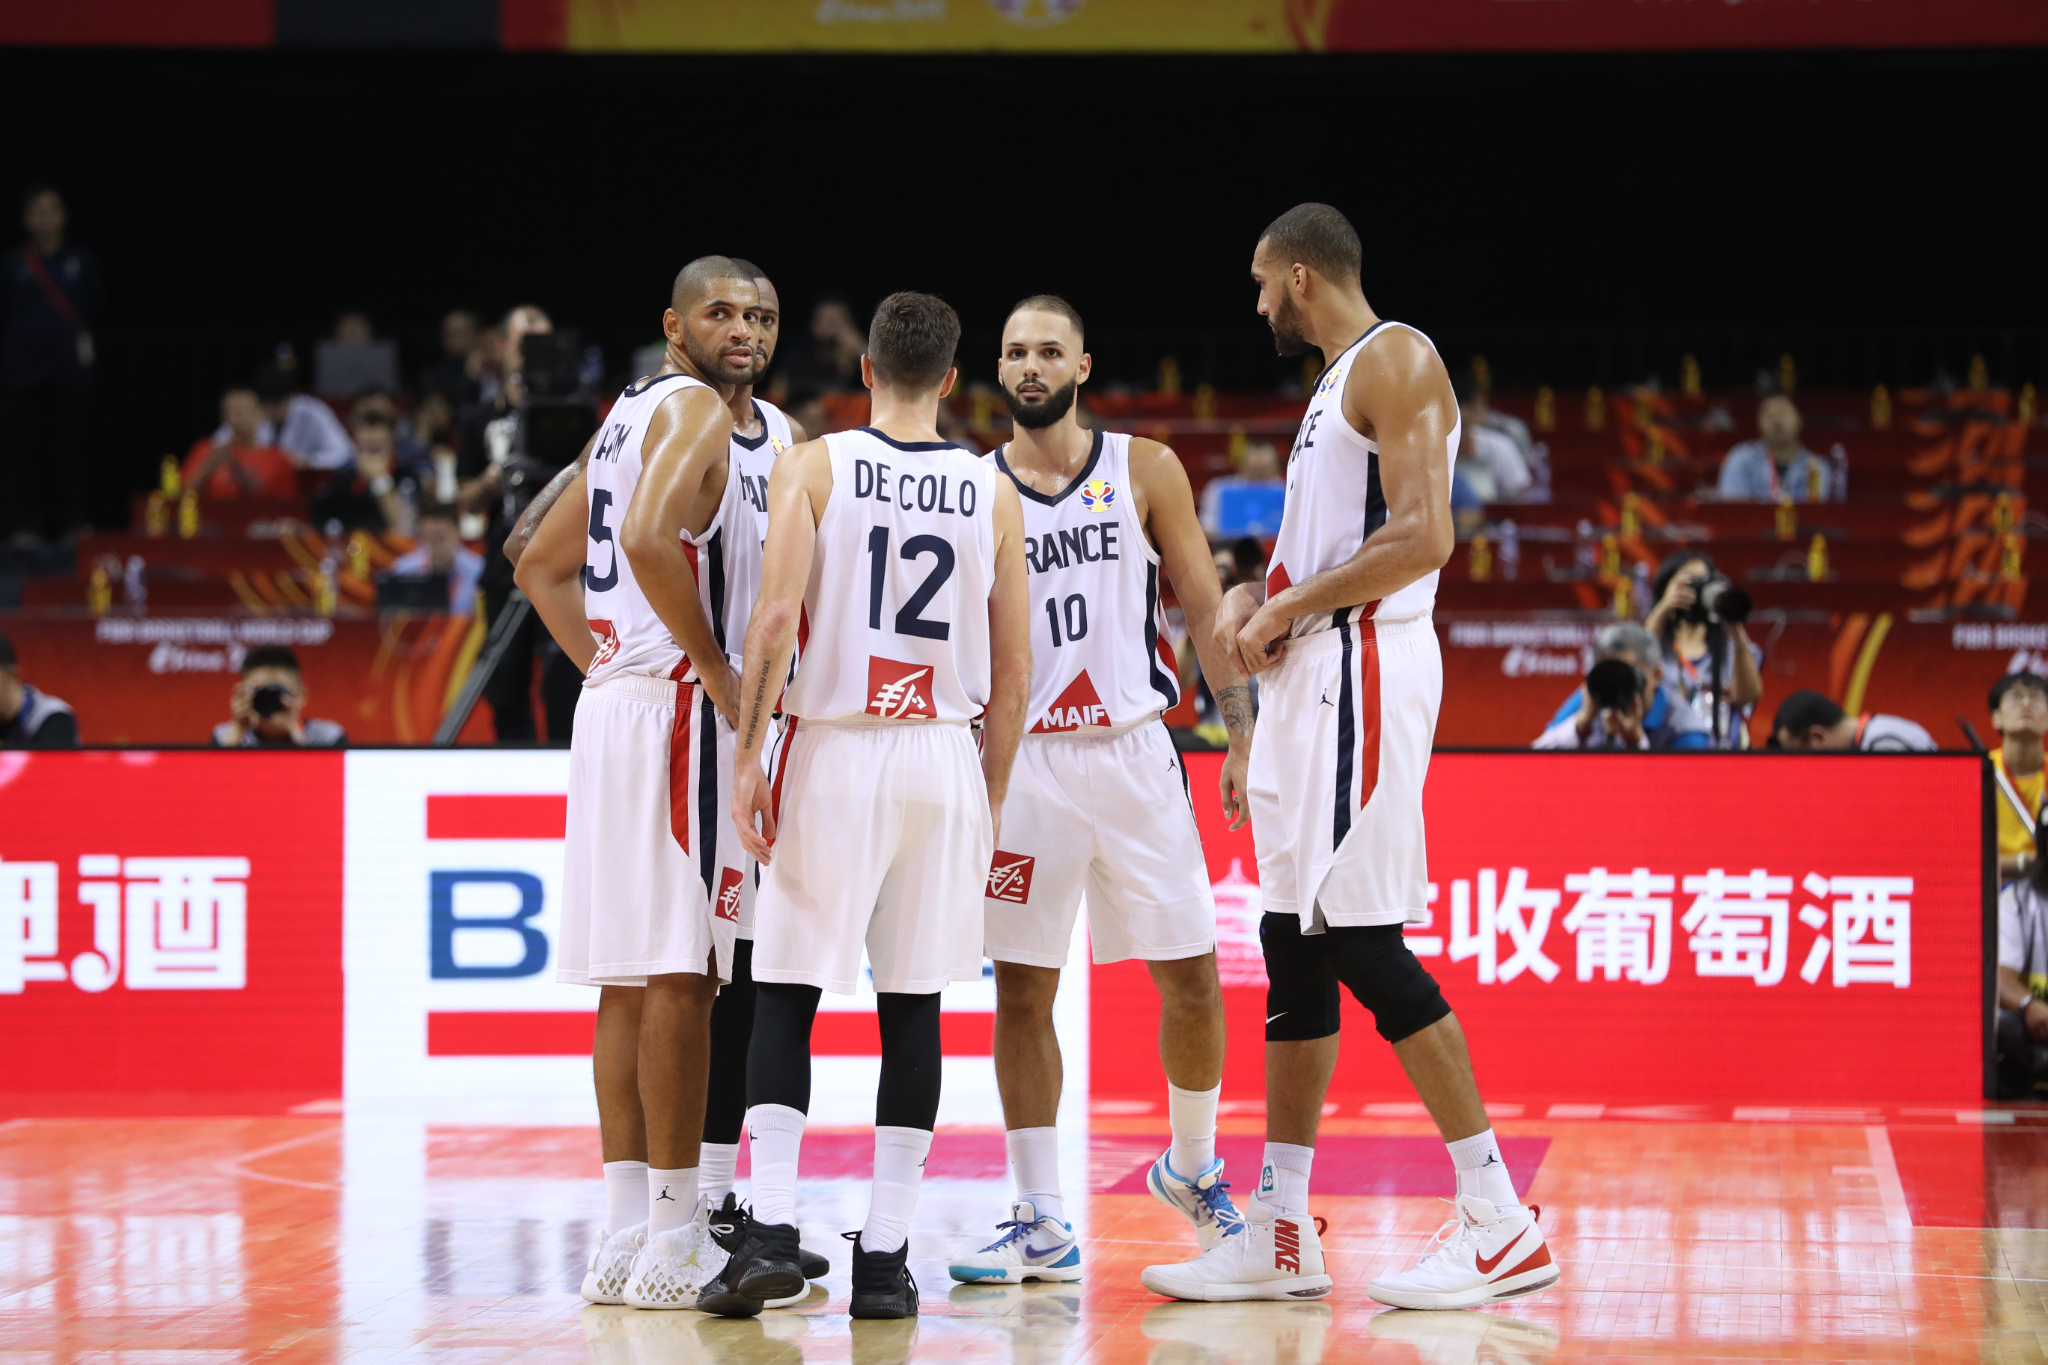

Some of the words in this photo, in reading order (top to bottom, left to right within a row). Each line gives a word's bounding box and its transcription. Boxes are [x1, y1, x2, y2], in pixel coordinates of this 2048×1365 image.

[855, 459, 892, 503] DE
[899, 474, 977, 518] COLO
[586, 488, 619, 593] 5
[1025, 521, 1120, 575] RANCE
[867, 525, 956, 641] 12
[1045, 592, 1089, 648] 10
[1040, 703, 1107, 730] MAIF
[1274, 1218, 1300, 1276] NIKE
